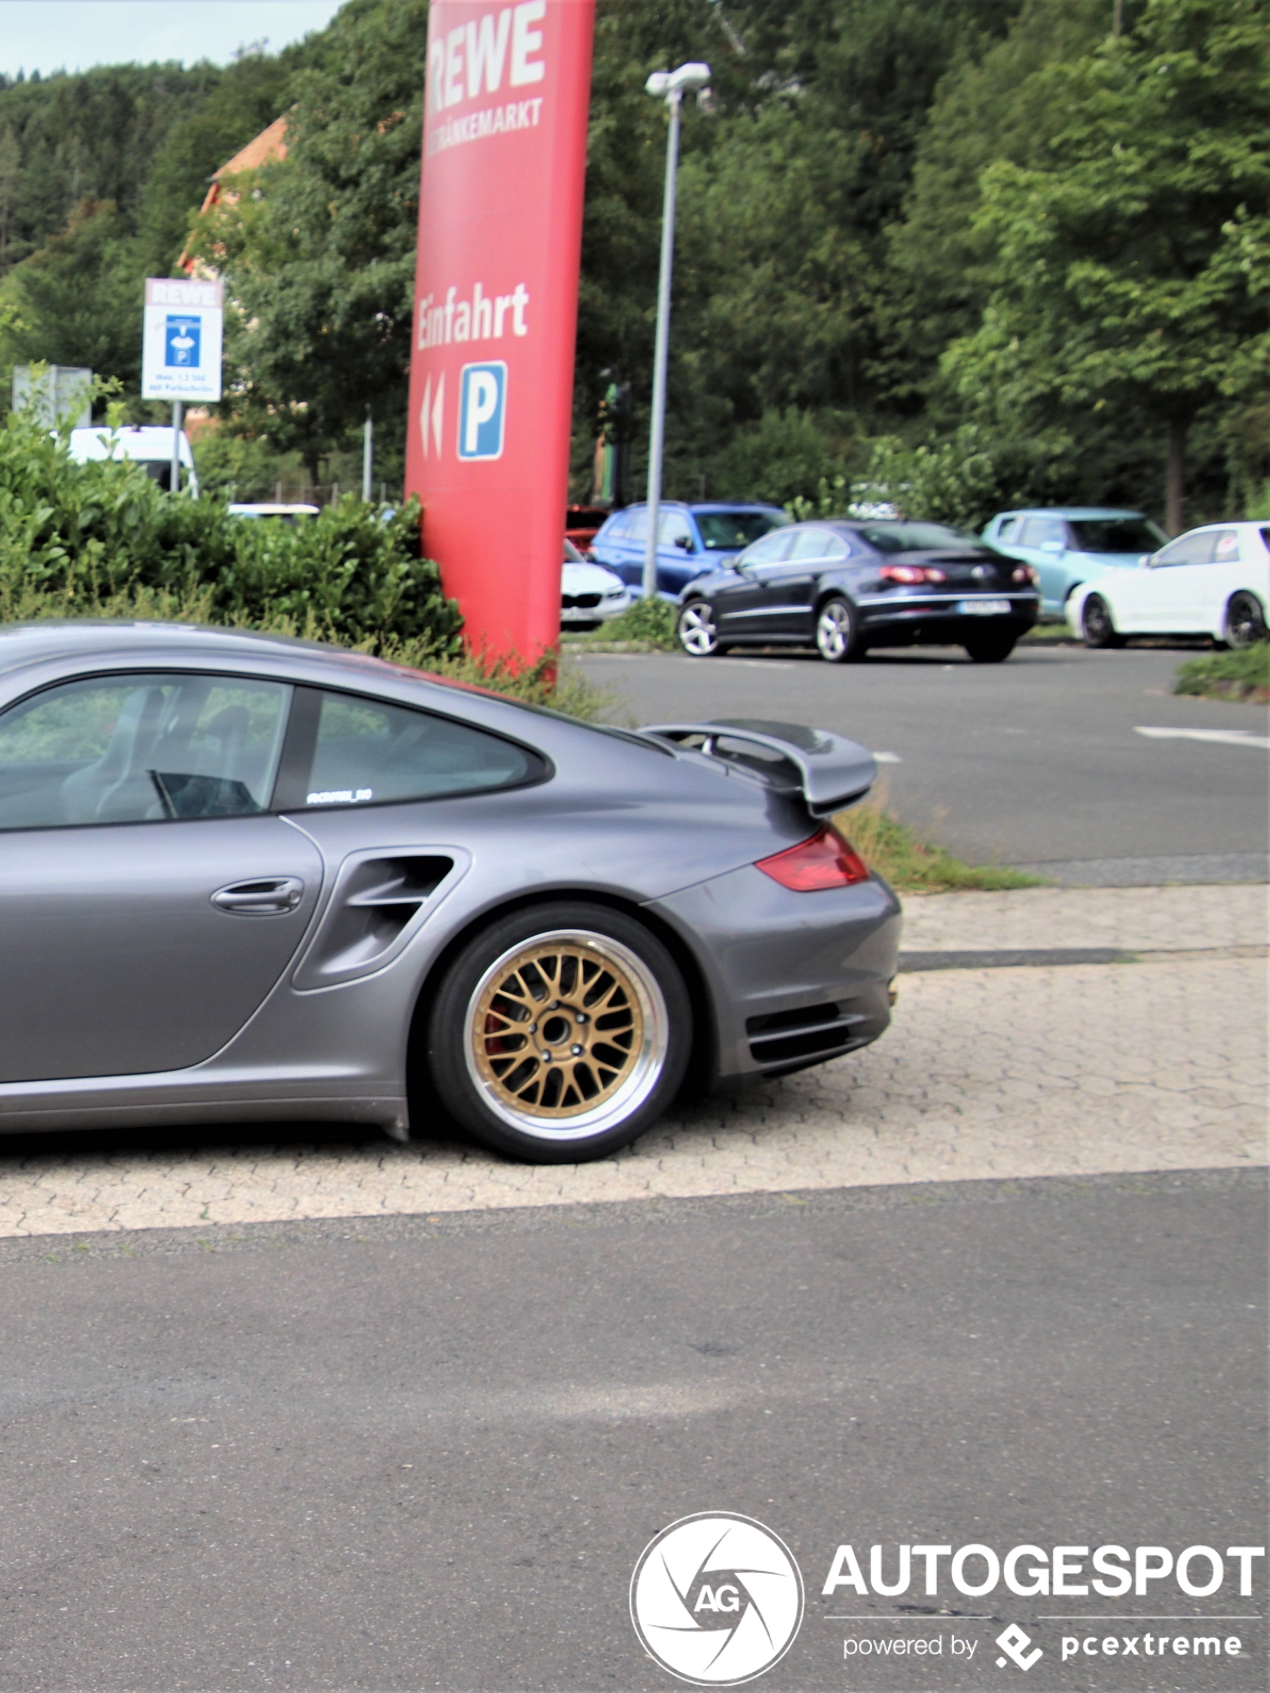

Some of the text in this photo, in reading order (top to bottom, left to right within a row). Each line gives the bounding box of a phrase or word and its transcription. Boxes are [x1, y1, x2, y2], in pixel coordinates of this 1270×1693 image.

[429, 0, 546, 118] REWE
[152, 283, 217, 306] REWE
[417, 281, 528, 351] Einfahrt
[465, 370, 498, 453] P
